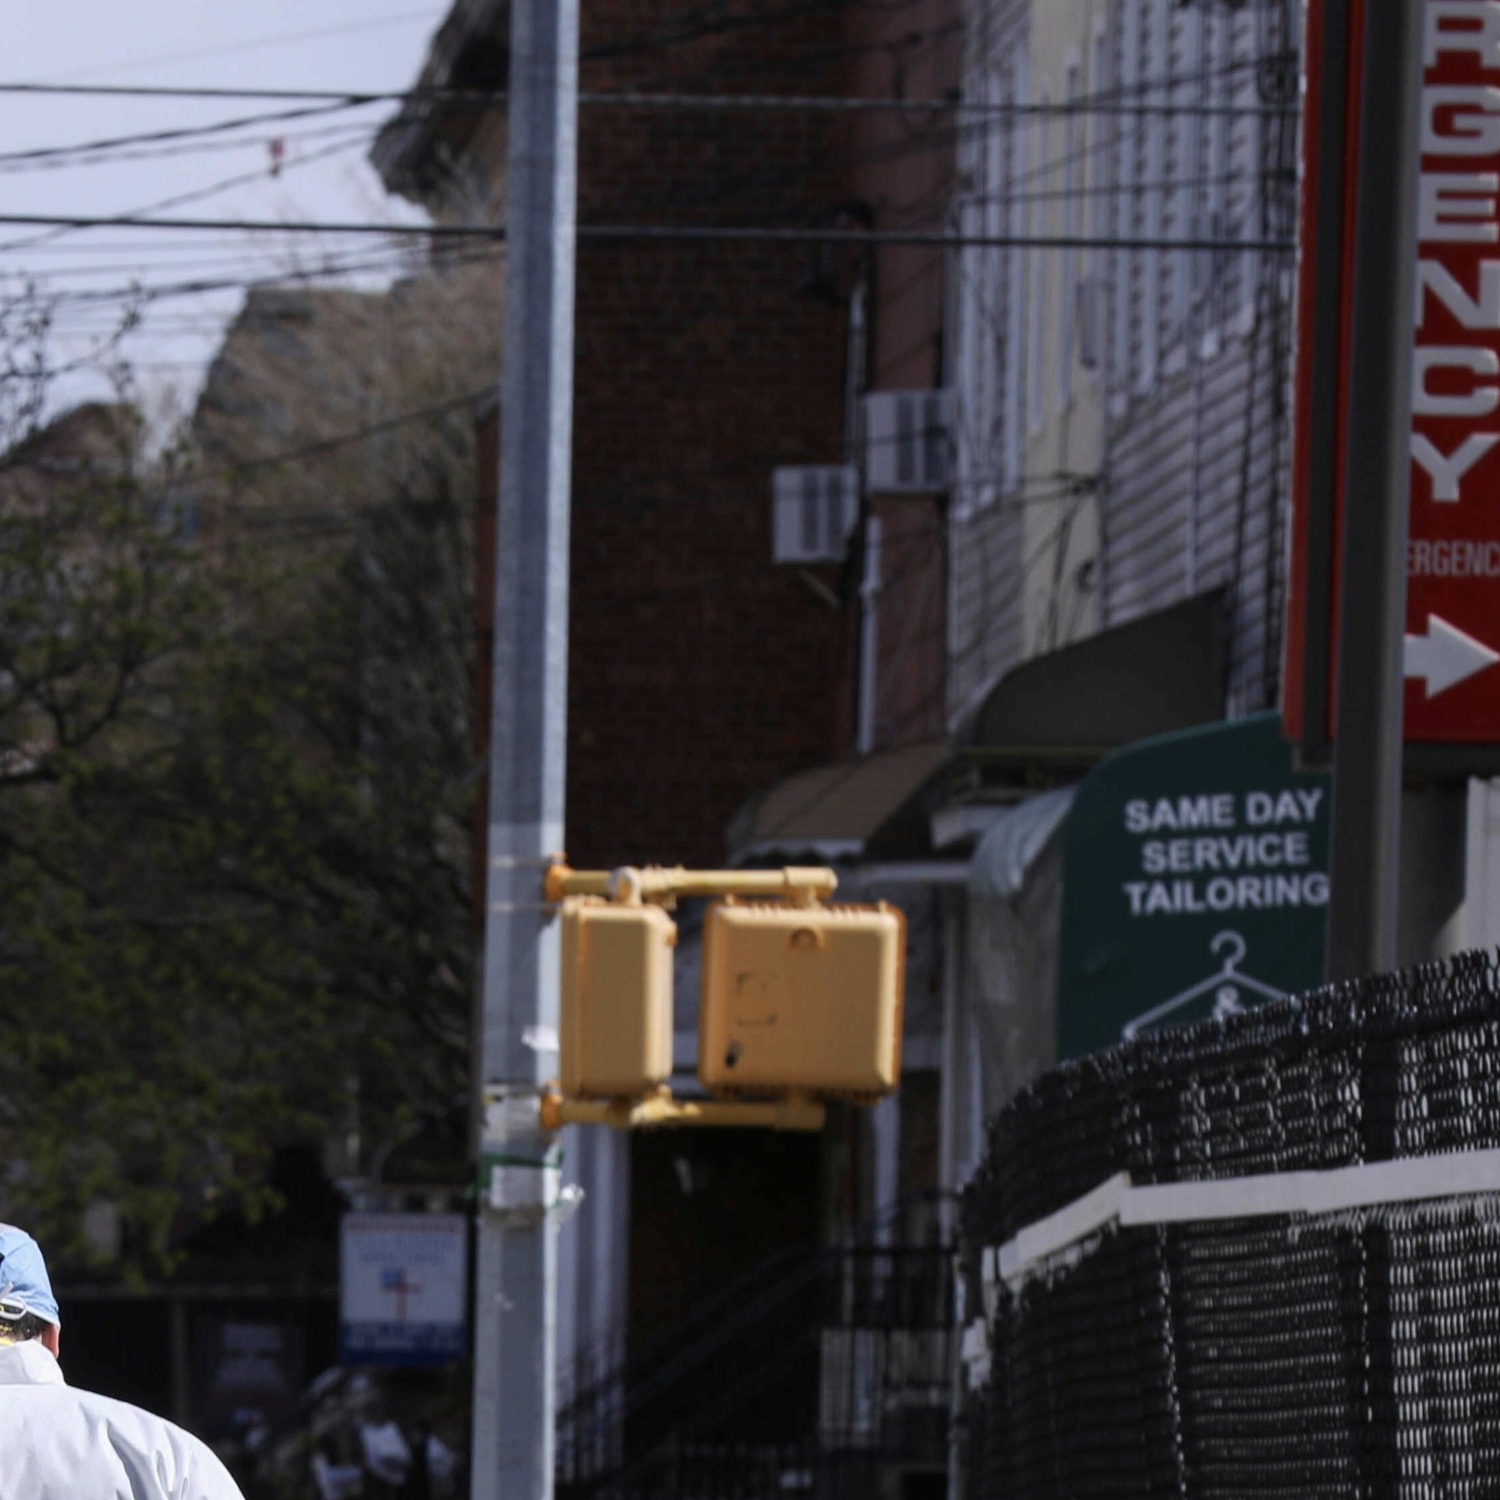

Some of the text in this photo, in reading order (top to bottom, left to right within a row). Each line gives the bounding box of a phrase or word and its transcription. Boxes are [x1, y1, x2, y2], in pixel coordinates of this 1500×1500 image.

[1125, 789, 1324, 832] SAME DAY
[1143, 833, 1310, 873] SERVICE
[1124, 873, 1330, 914] TAILORING
